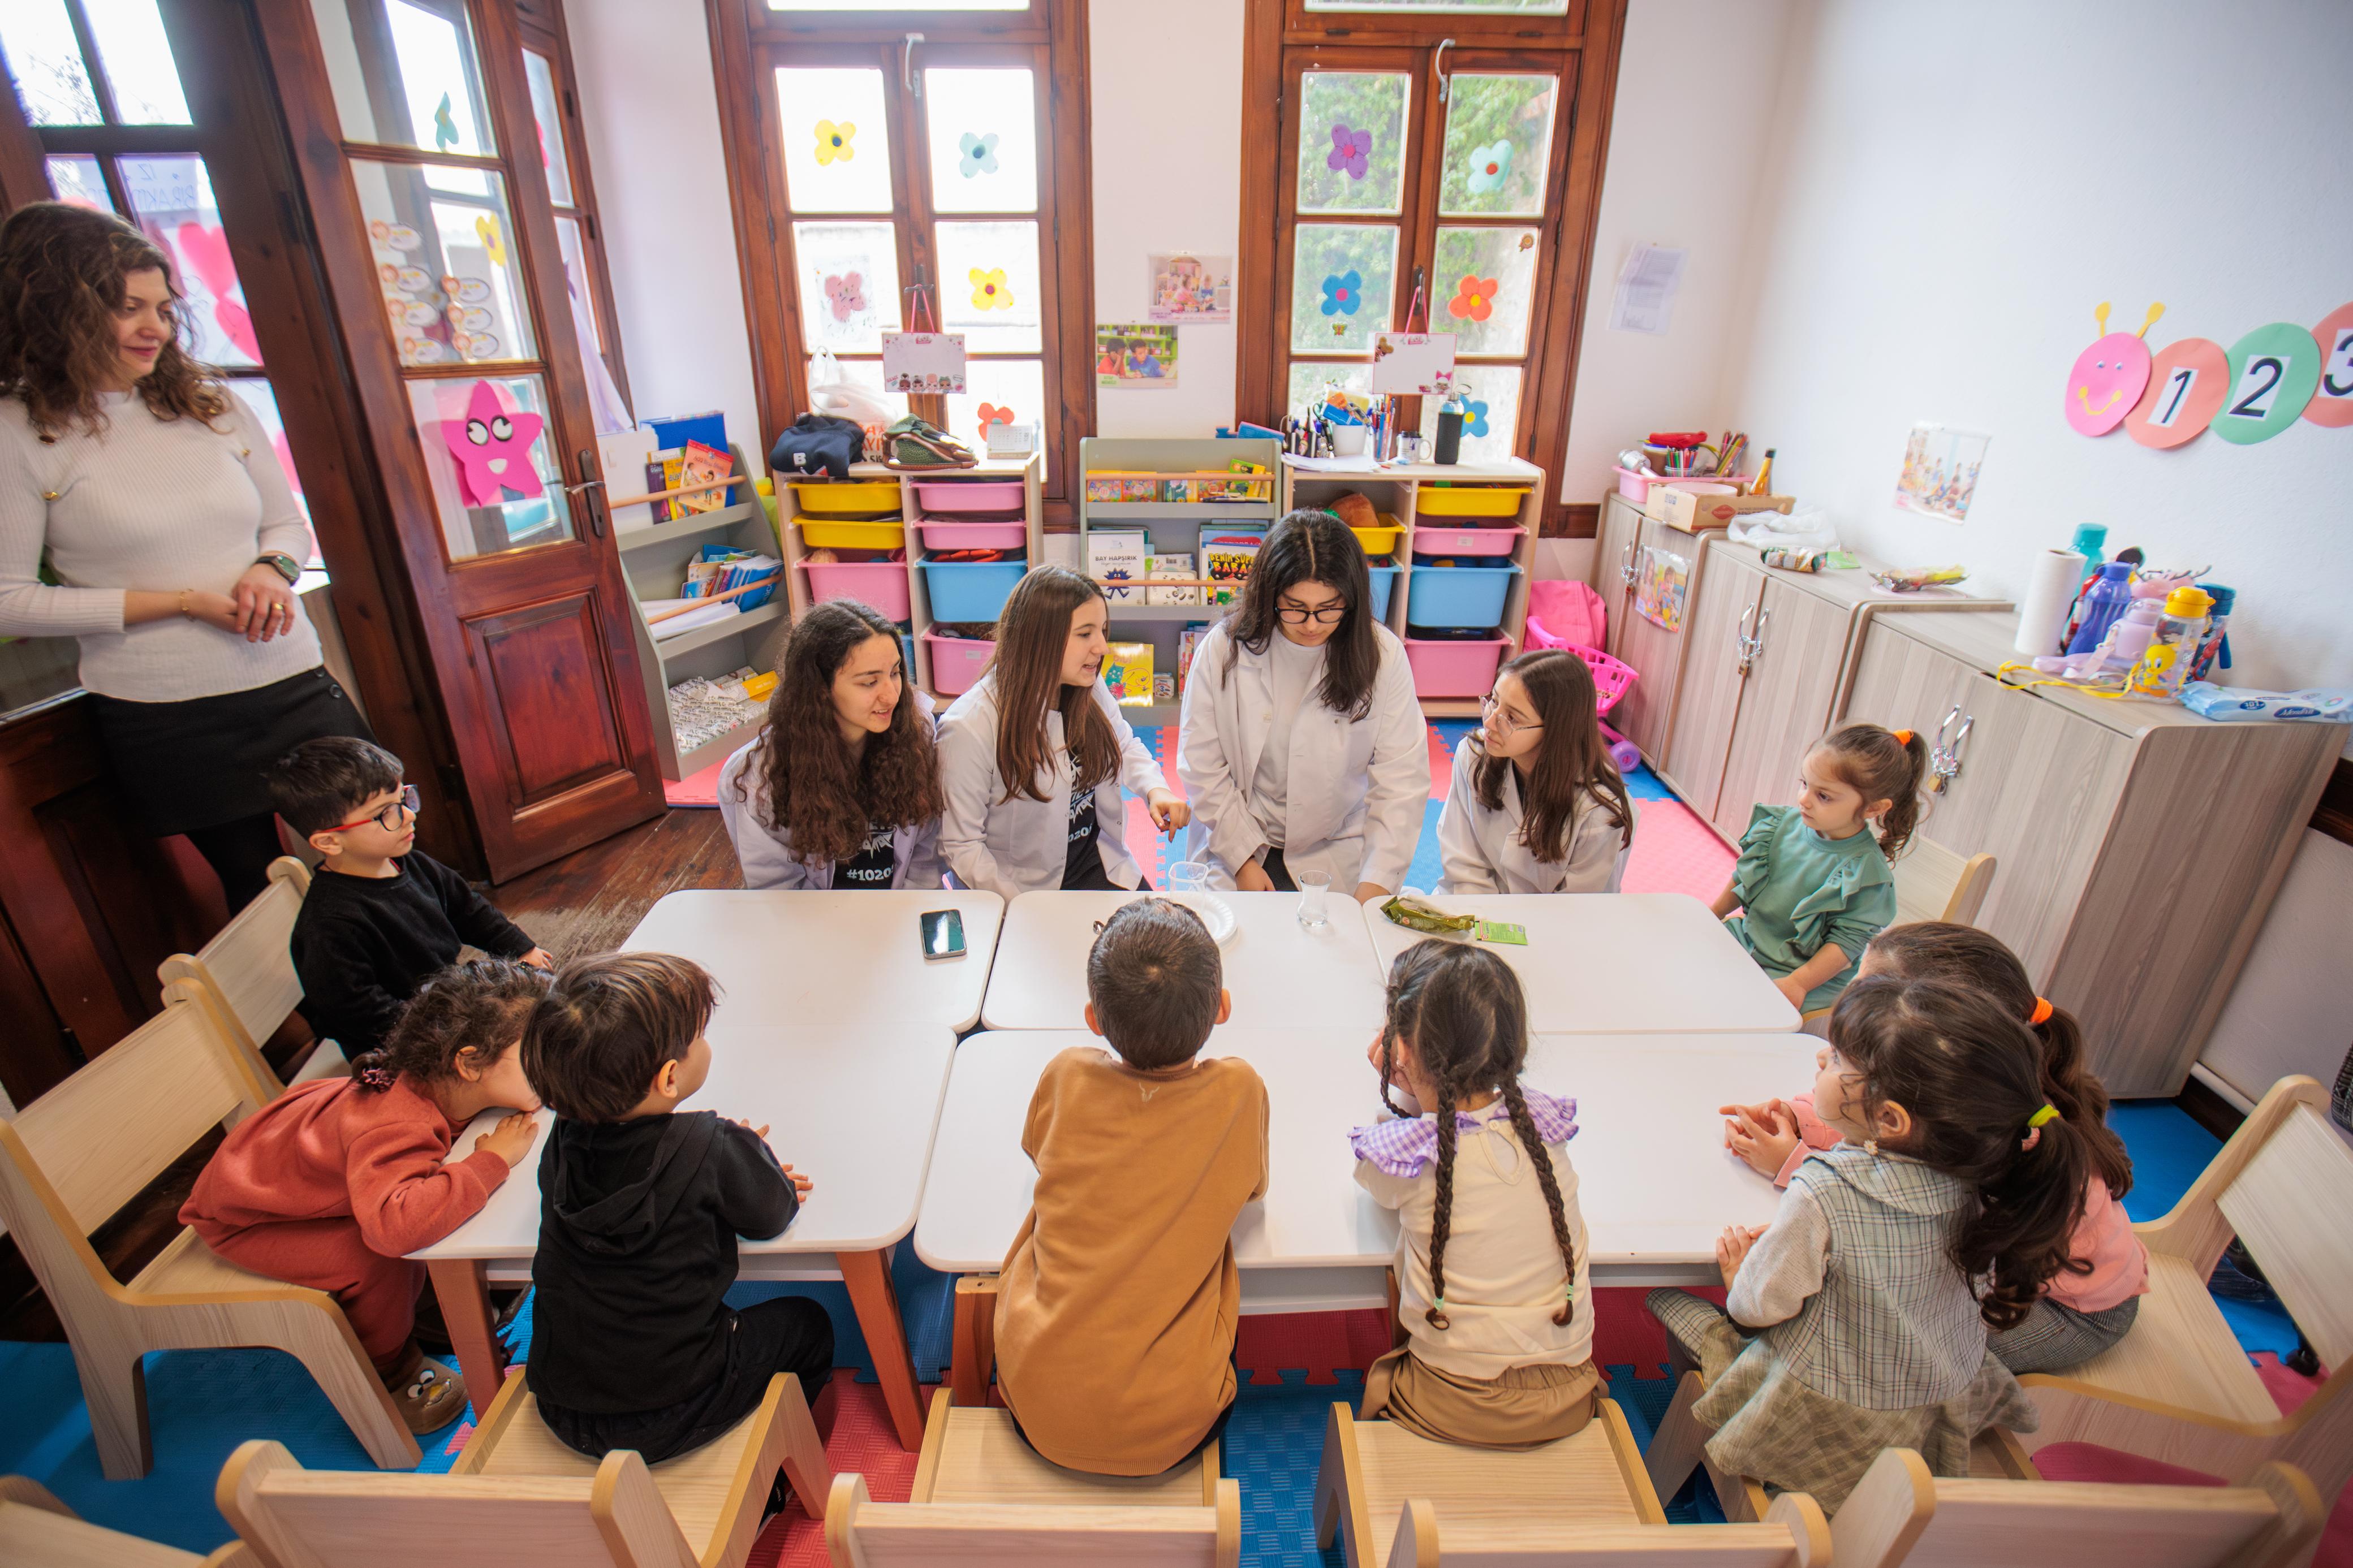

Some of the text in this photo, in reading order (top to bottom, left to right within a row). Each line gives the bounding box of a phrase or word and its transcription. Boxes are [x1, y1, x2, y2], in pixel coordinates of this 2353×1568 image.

[2161, 334, 2353, 424] 1 2 3
[793, 452, 806, 466] B
[1209, 552, 1232, 563] BENİM
